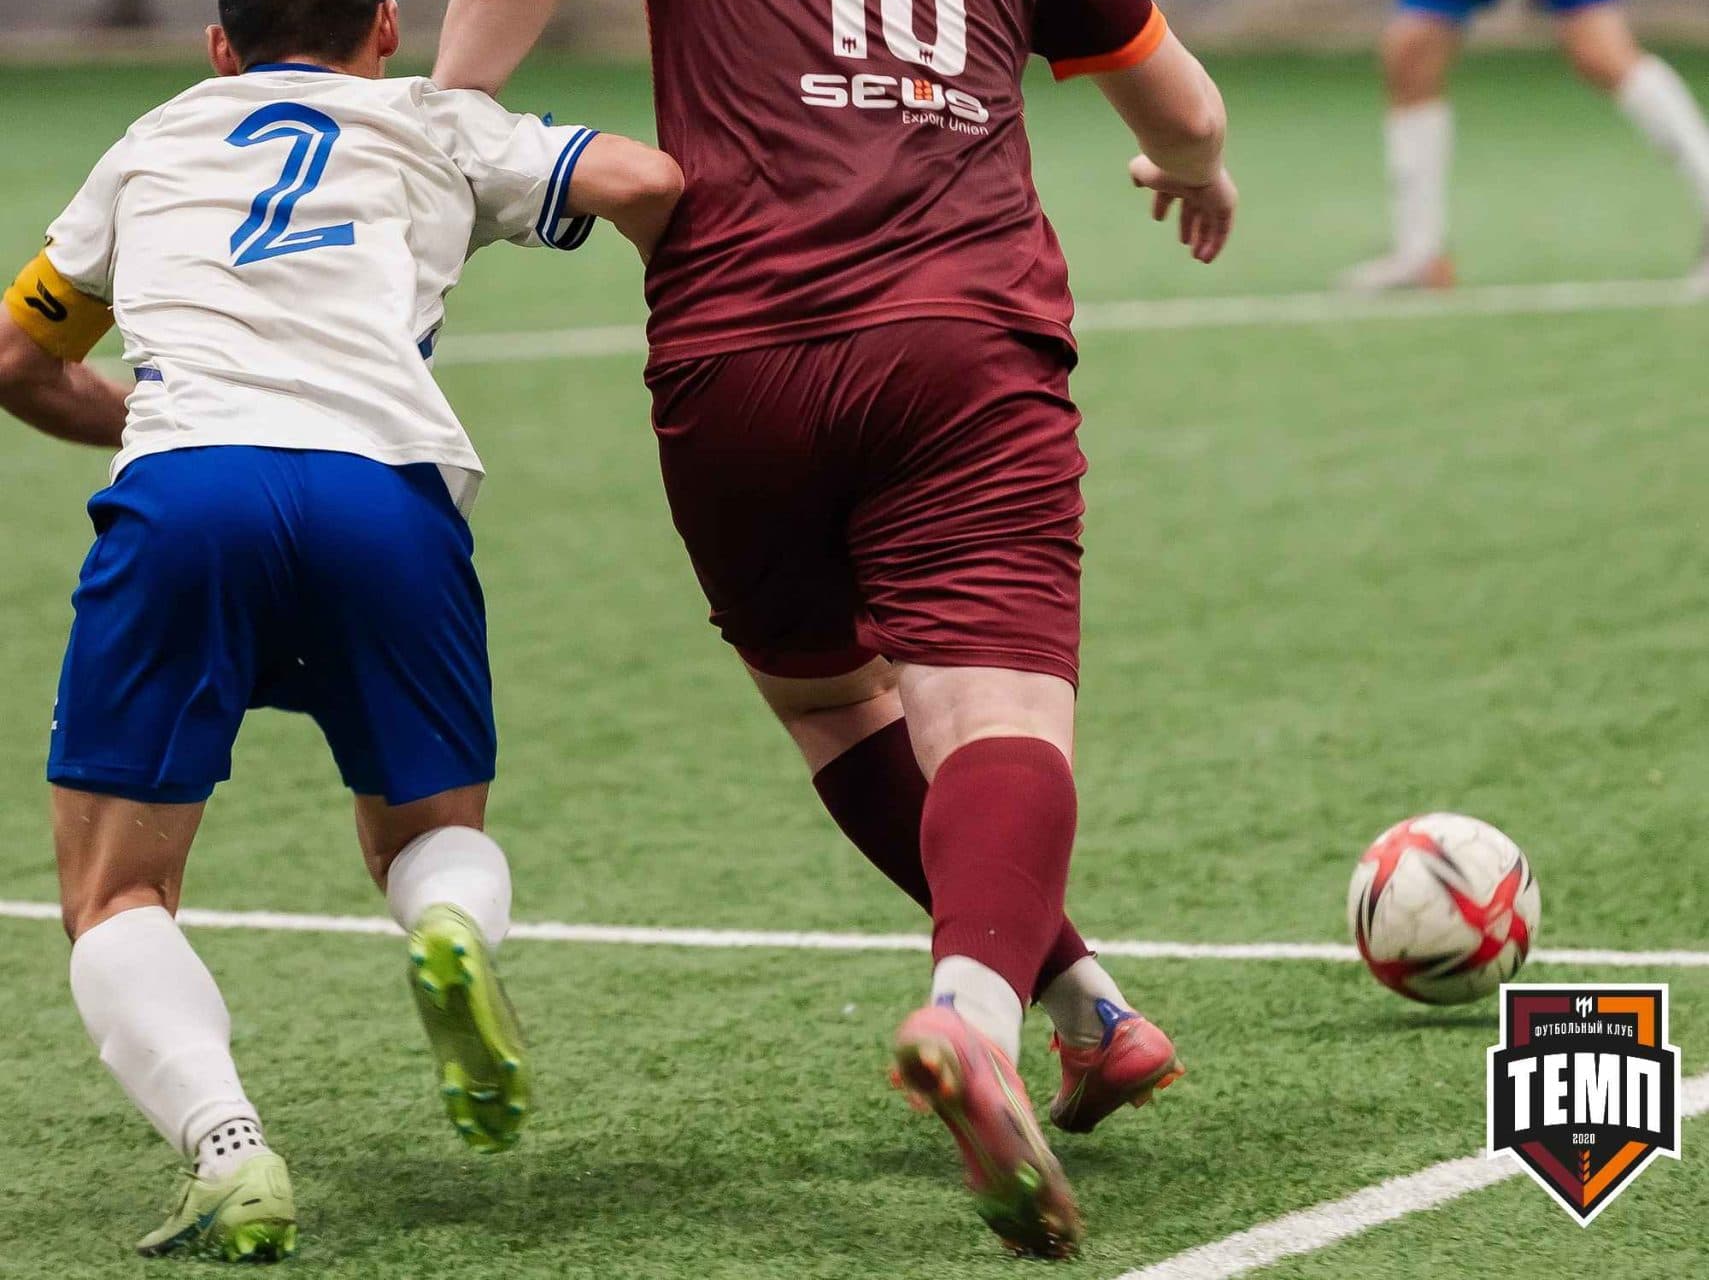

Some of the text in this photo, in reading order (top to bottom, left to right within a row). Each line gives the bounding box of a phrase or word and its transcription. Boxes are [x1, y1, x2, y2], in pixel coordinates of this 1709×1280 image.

[800, 73, 989, 123] SEUS
[902, 110, 989, 136] Export Union
[224, 102, 355, 267] 2
